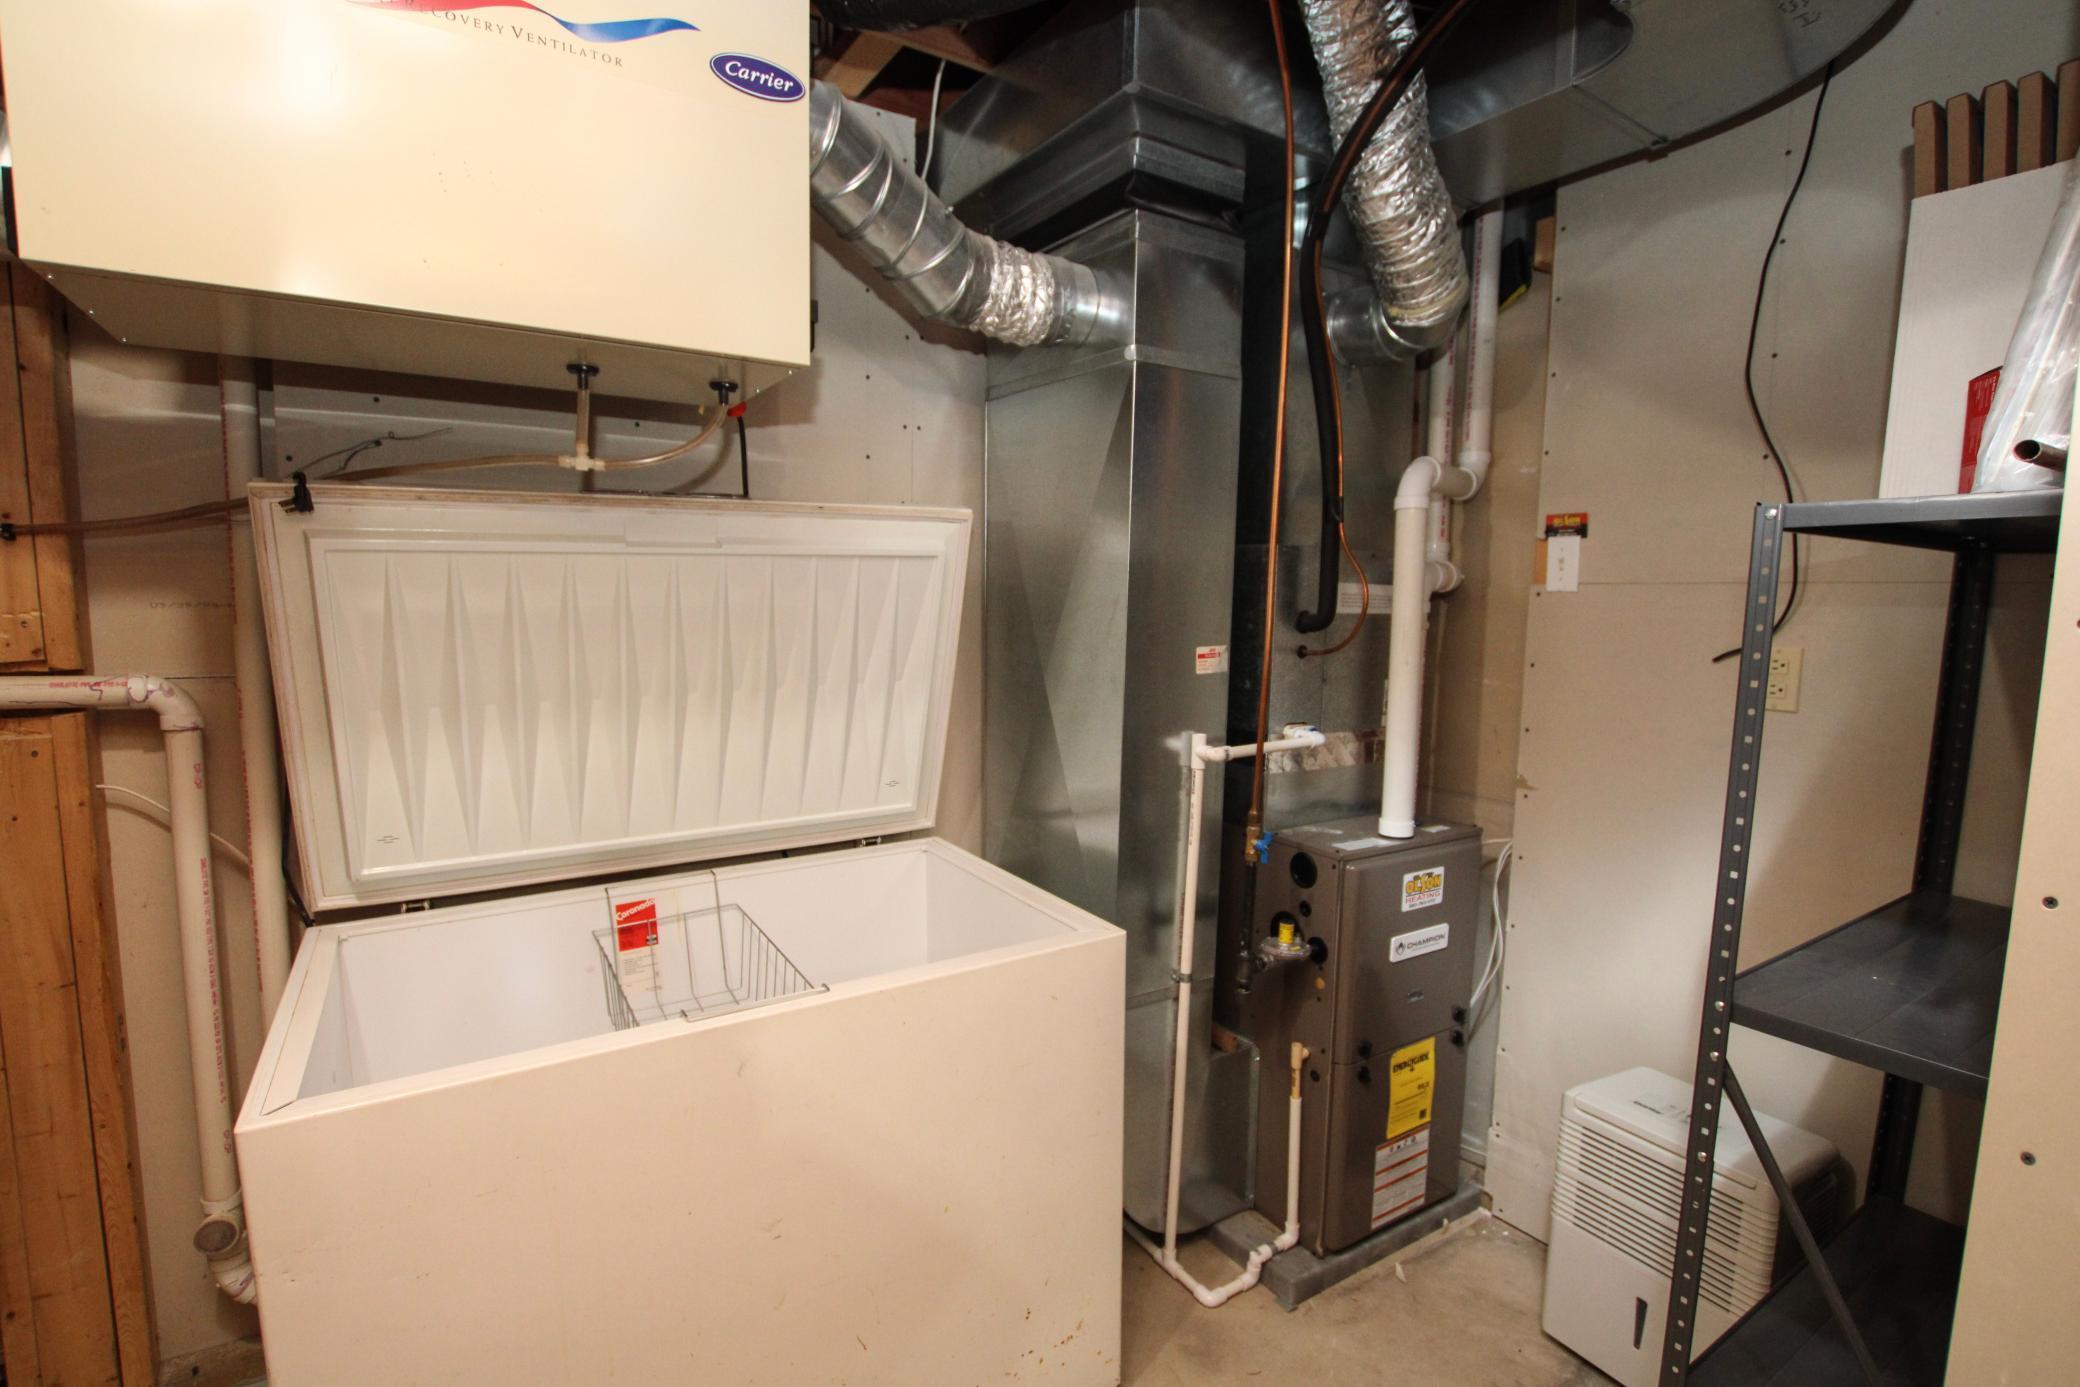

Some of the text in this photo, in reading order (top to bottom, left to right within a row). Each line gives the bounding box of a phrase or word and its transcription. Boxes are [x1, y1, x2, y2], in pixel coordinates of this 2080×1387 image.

[511, 25, 624, 67] VENTILATOR
[725, 61, 794, 92] Carrier
[1405, 891, 1441, 904] HEATING
[617, 898, 656, 920] Coronado
[1407, 934, 1446, 949] CHAMPION
